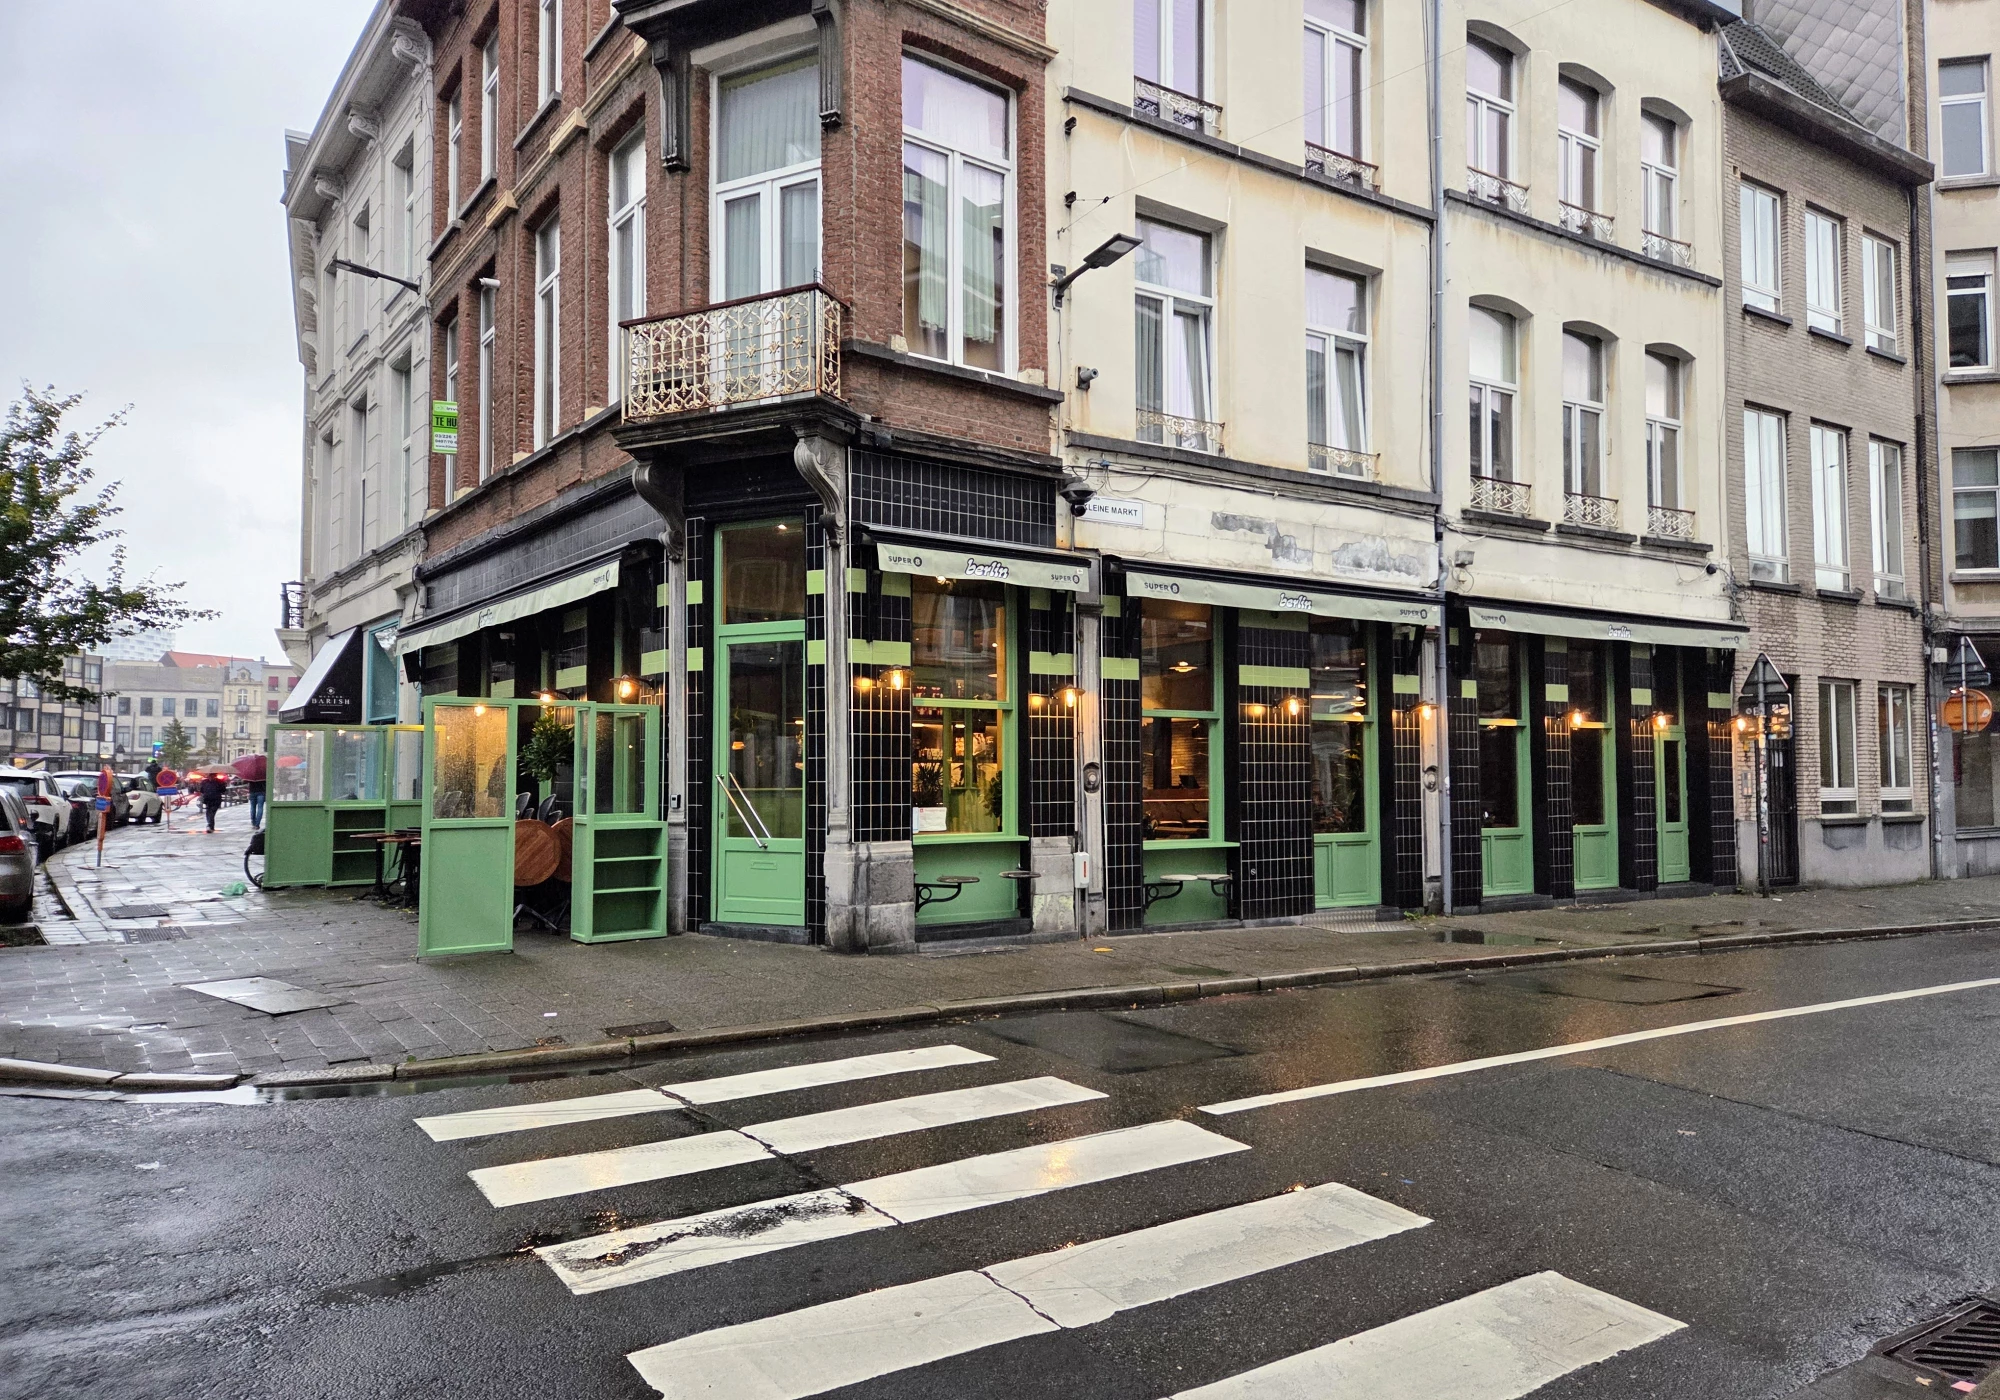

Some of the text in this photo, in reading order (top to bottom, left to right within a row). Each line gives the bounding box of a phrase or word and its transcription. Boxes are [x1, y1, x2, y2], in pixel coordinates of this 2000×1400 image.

[435, 416, 445, 426] TE
[1111, 506, 1138, 517] MARKT
[888, 555, 912, 564] SUPER
[965, 557, 1009, 579] berlin
[1050, 574, 1072, 582] SUPER
[1144, 581, 1169, 591] SUPER
[1278, 592, 1312, 610] berlin
